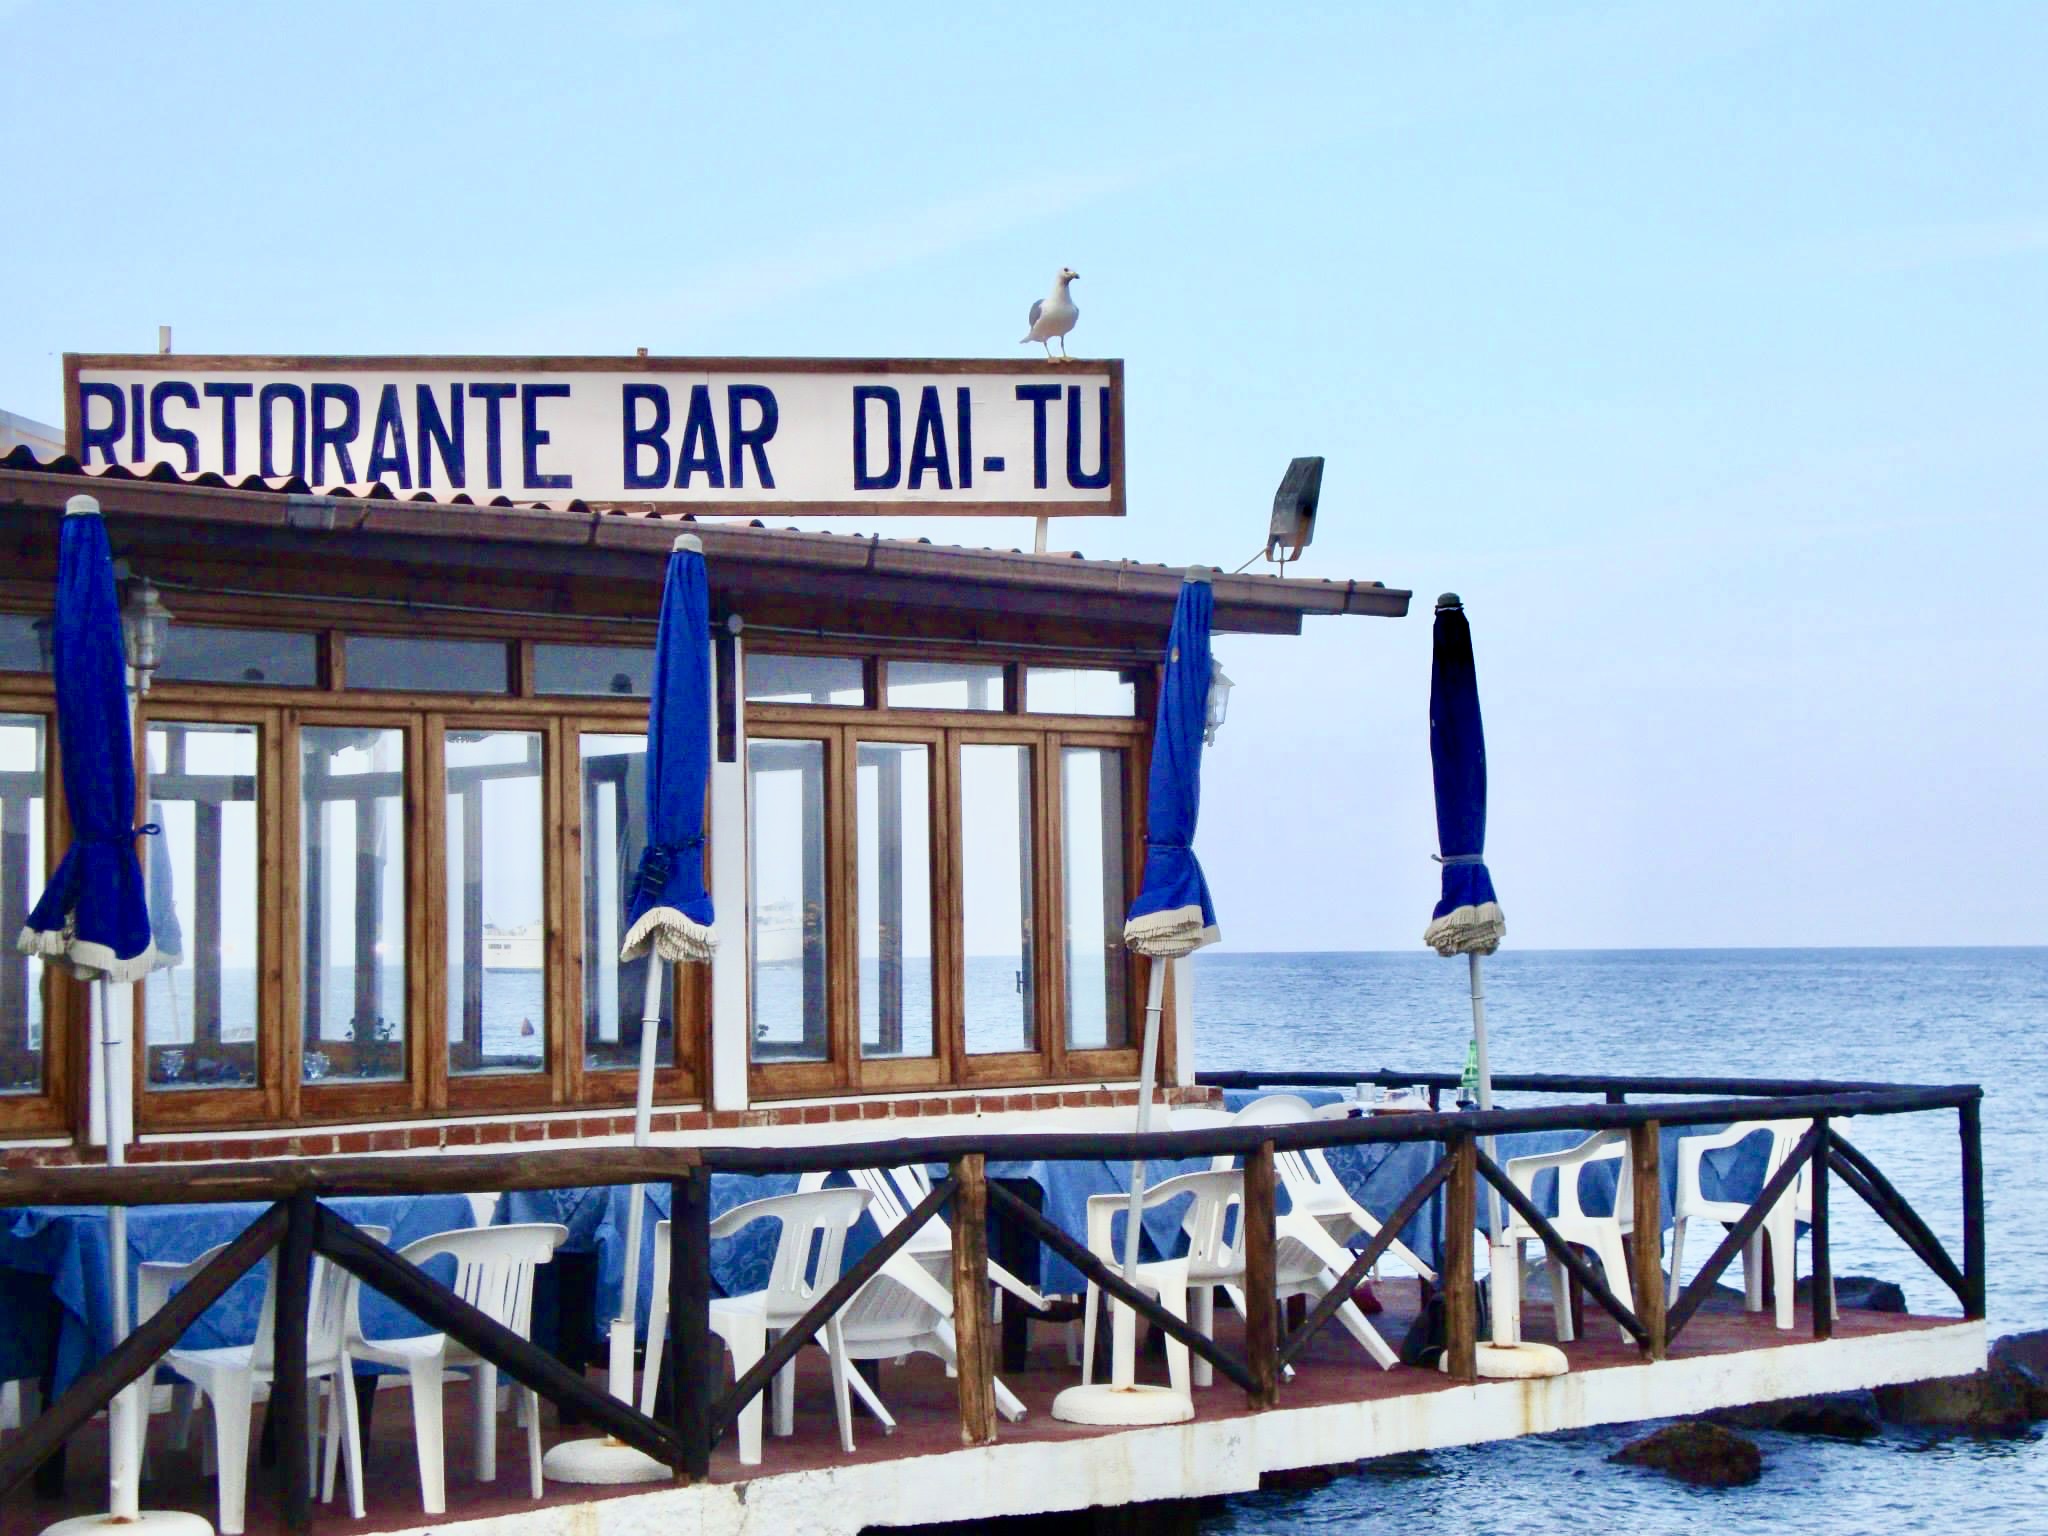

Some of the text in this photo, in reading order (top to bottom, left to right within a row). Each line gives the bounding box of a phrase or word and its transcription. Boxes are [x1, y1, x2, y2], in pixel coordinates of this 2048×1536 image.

[80, 381, 1111, 490] RISTORANTE BAR DAI-TU
